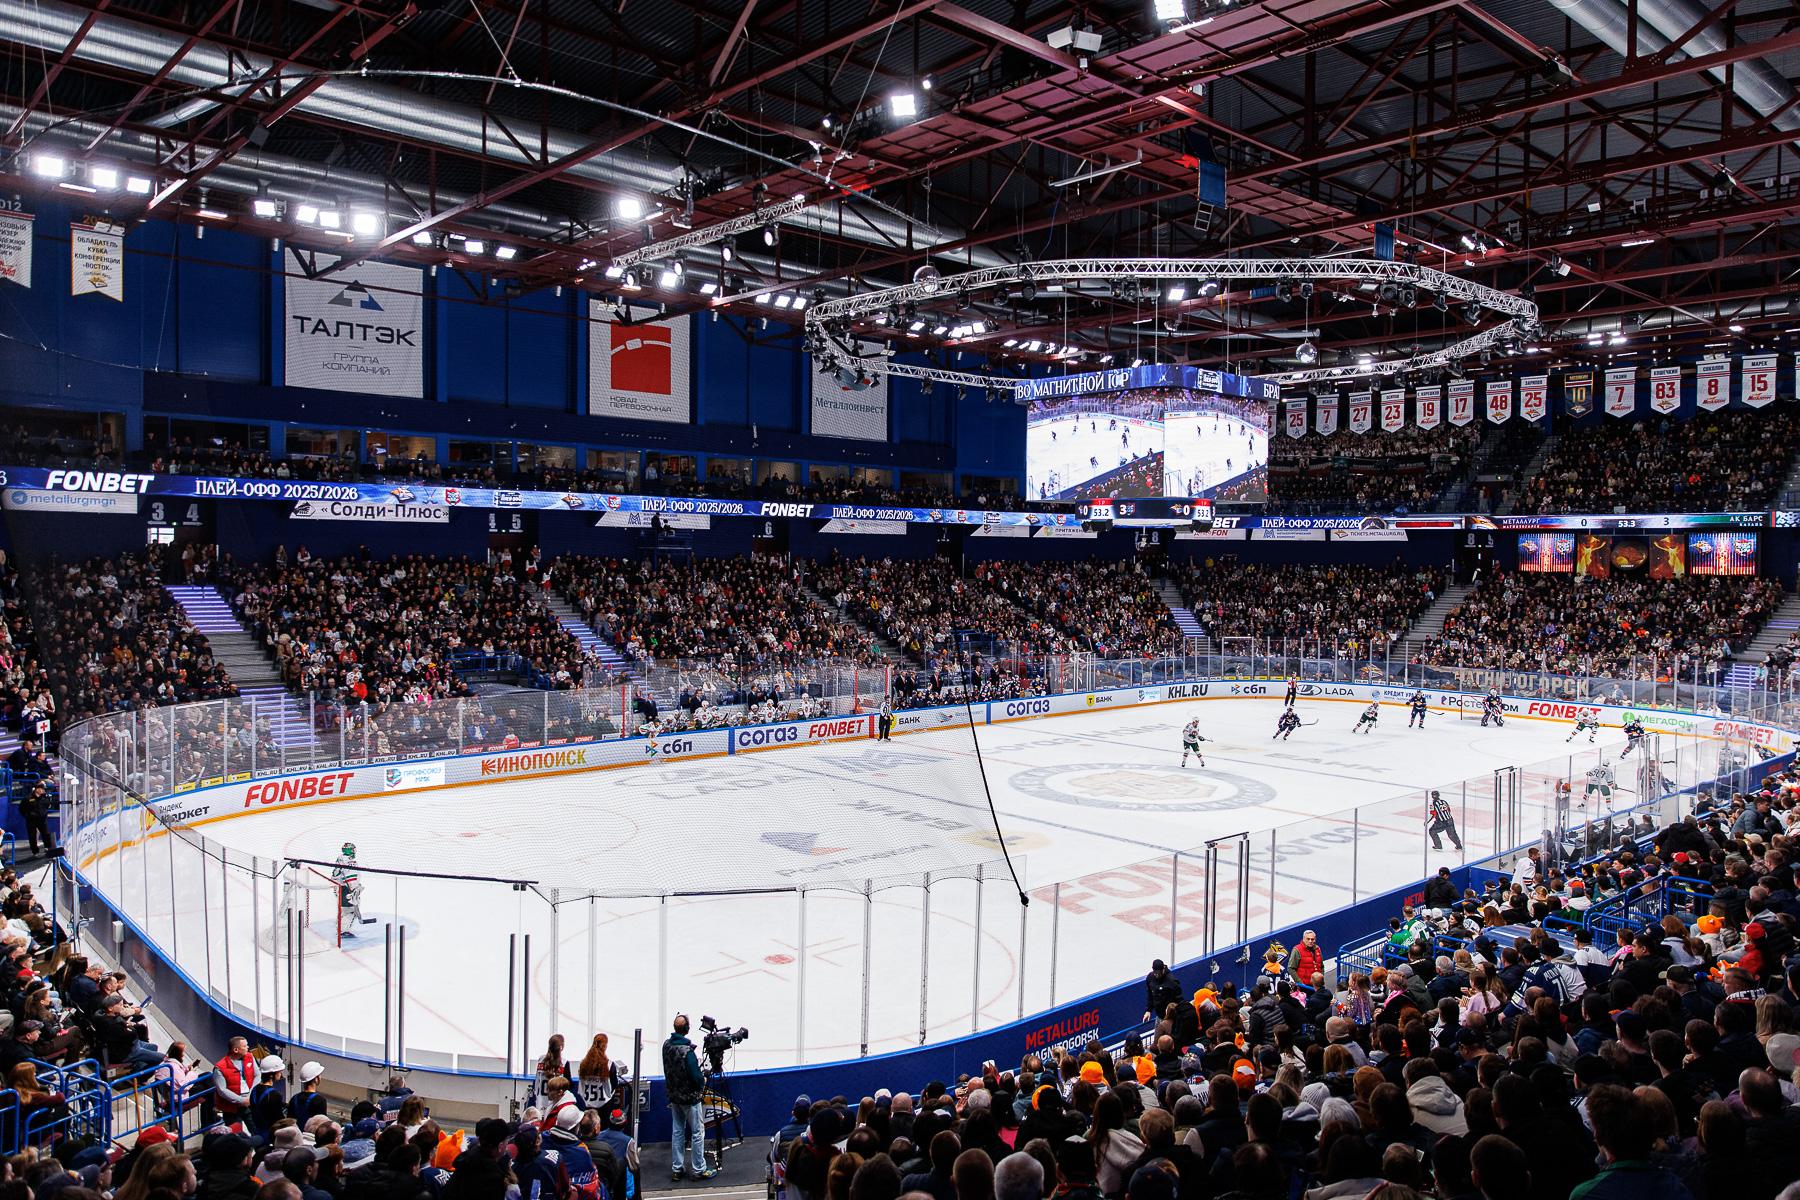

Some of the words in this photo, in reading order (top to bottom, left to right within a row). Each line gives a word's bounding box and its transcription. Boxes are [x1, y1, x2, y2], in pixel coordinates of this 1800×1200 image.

[77, 236, 119, 248] ОБЛАДАТЕЛЬ
[87, 246, 108, 255] КУБКА
[74, 253, 121, 265] КОНФЕРЕНЦИИ
[292, 315, 417, 347] ТАЛТЭК
[332, 351, 380, 365] ГРУППА
[322, 361, 392, 376] КОМПАНИЙ
[1033, 372, 1104, 396] МАГНИТНОЙ
[1655, 381, 1675, 399] 83
[1707, 379, 1719, 395] 8
[1750, 374, 1768, 392] 15
[610, 395, 638, 404] НОВАЯ
[1524, 392, 1542, 408] 25
[1572, 387, 1587, 403] 10
[1615, 386, 1625, 402] 7
[609, 401, 672, 413] ПЕРЕВОЗОЧНАЯ
[815, 396, 885, 415] Металлоинвест
[1422, 402, 1435, 417] 19
[1454, 398, 1468, 413] 17
[1489, 395, 1508, 410] 48
[1289, 413, 1304, 427] 25
[1323, 410, 1330, 423] 7
[1353, 407, 1368, 422] 27
[1384, 405, 1401, 420] 23
[46, 469, 155, 494] FONBET
[195, 479, 281, 498] ПЛЕЙ-ОФФ
[283, 484, 359, 500] 2025/2026
[30, 494, 117, 507] metallurgmgn
[641, 498, 695, 512] ПЛЕЙ-ОФФ
[696, 501, 744, 514] 2025/2026
[151, 502, 165, 521] 3
[186, 503, 200, 522] 4
[760, 502, 815, 518] FONBET
[832, 506, 875, 519] ПЛЕЙ-ОФФ
[876, 509, 914, 520] 2025/2026
[1093, 508, 1110, 517] 53.2
[1119, 504, 1127, 515] 3
[1183, 505, 1190, 516] 0
[512, 513, 521, 530] 5
[764, 521, 773, 535] 6
[1211, 517, 1241, 528] BET
[1261, 517, 1311, 528] ПЛЕЙ-ОФФ
[1313, 518, 1360, 529] 2025/2026
[1581, 519, 1587, 527] 0
[1618, 520, 1636, 528] 53.3
[1663, 517, 1670, 526] 3
[1151, 531, 1159, 543] 8
[1168, 684, 1209, 699] KHL.RU
[1243, 684, 1266, 694] сбп
[1325, 687, 1354, 696] LADA
[1448, 697, 1519, 712] Ростеом
[898, 716, 921, 725] БАНК
[808, 719, 866, 739] FONBET
[662, 740, 693, 755] сбп
[481, 750, 587, 776] КИНОПОИСК
[244, 772, 355, 807] FONBET
[1025, 1008, 1100, 1050] METALLURG
[1030, 1027, 1100, 1062] AGNTOGORSK
